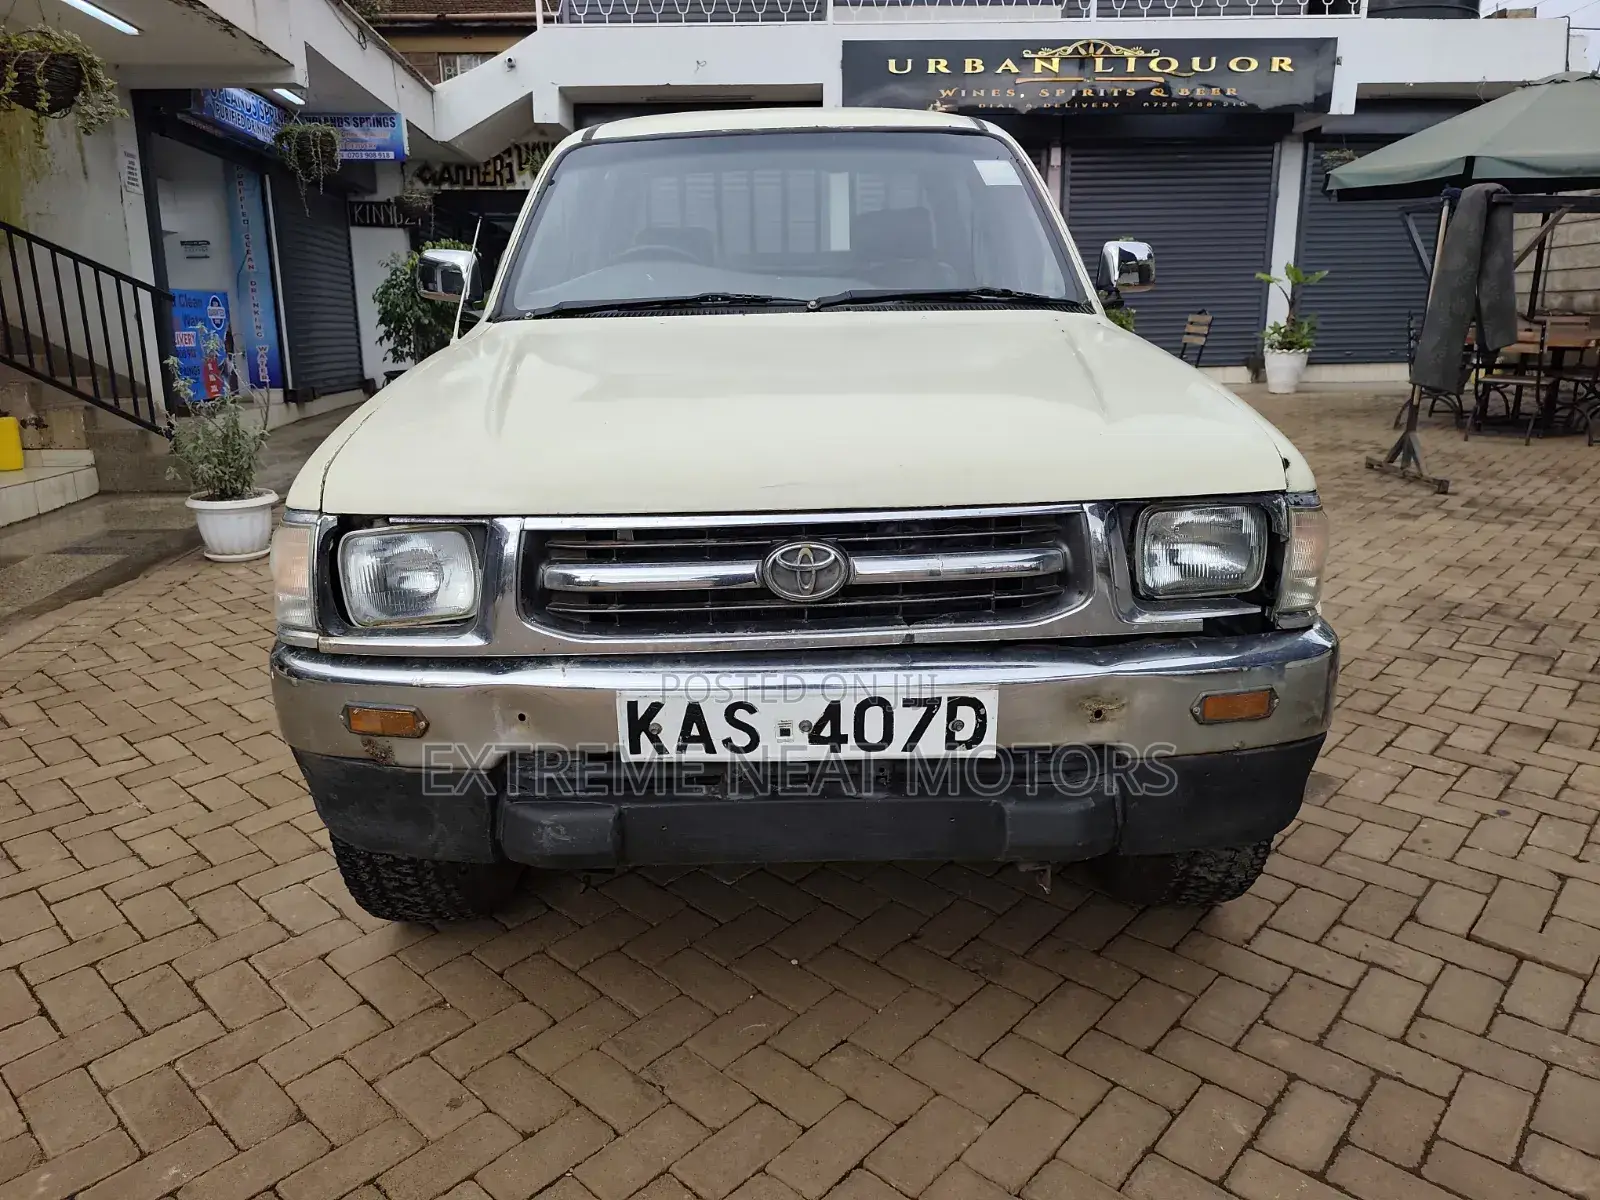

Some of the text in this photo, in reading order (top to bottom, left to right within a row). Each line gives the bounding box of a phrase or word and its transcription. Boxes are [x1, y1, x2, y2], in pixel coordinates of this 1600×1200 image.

[887, 56, 1295, 77] URBAN LIQUOR
[1039, 87, 1136, 98] SPIRITS
[1150, 87, 1169, 97] &
[1178, 87, 1238, 97] BEER
[353, 115, 396, 128] SPRINGS
[626, 696, 988, 756] KAS 407D
